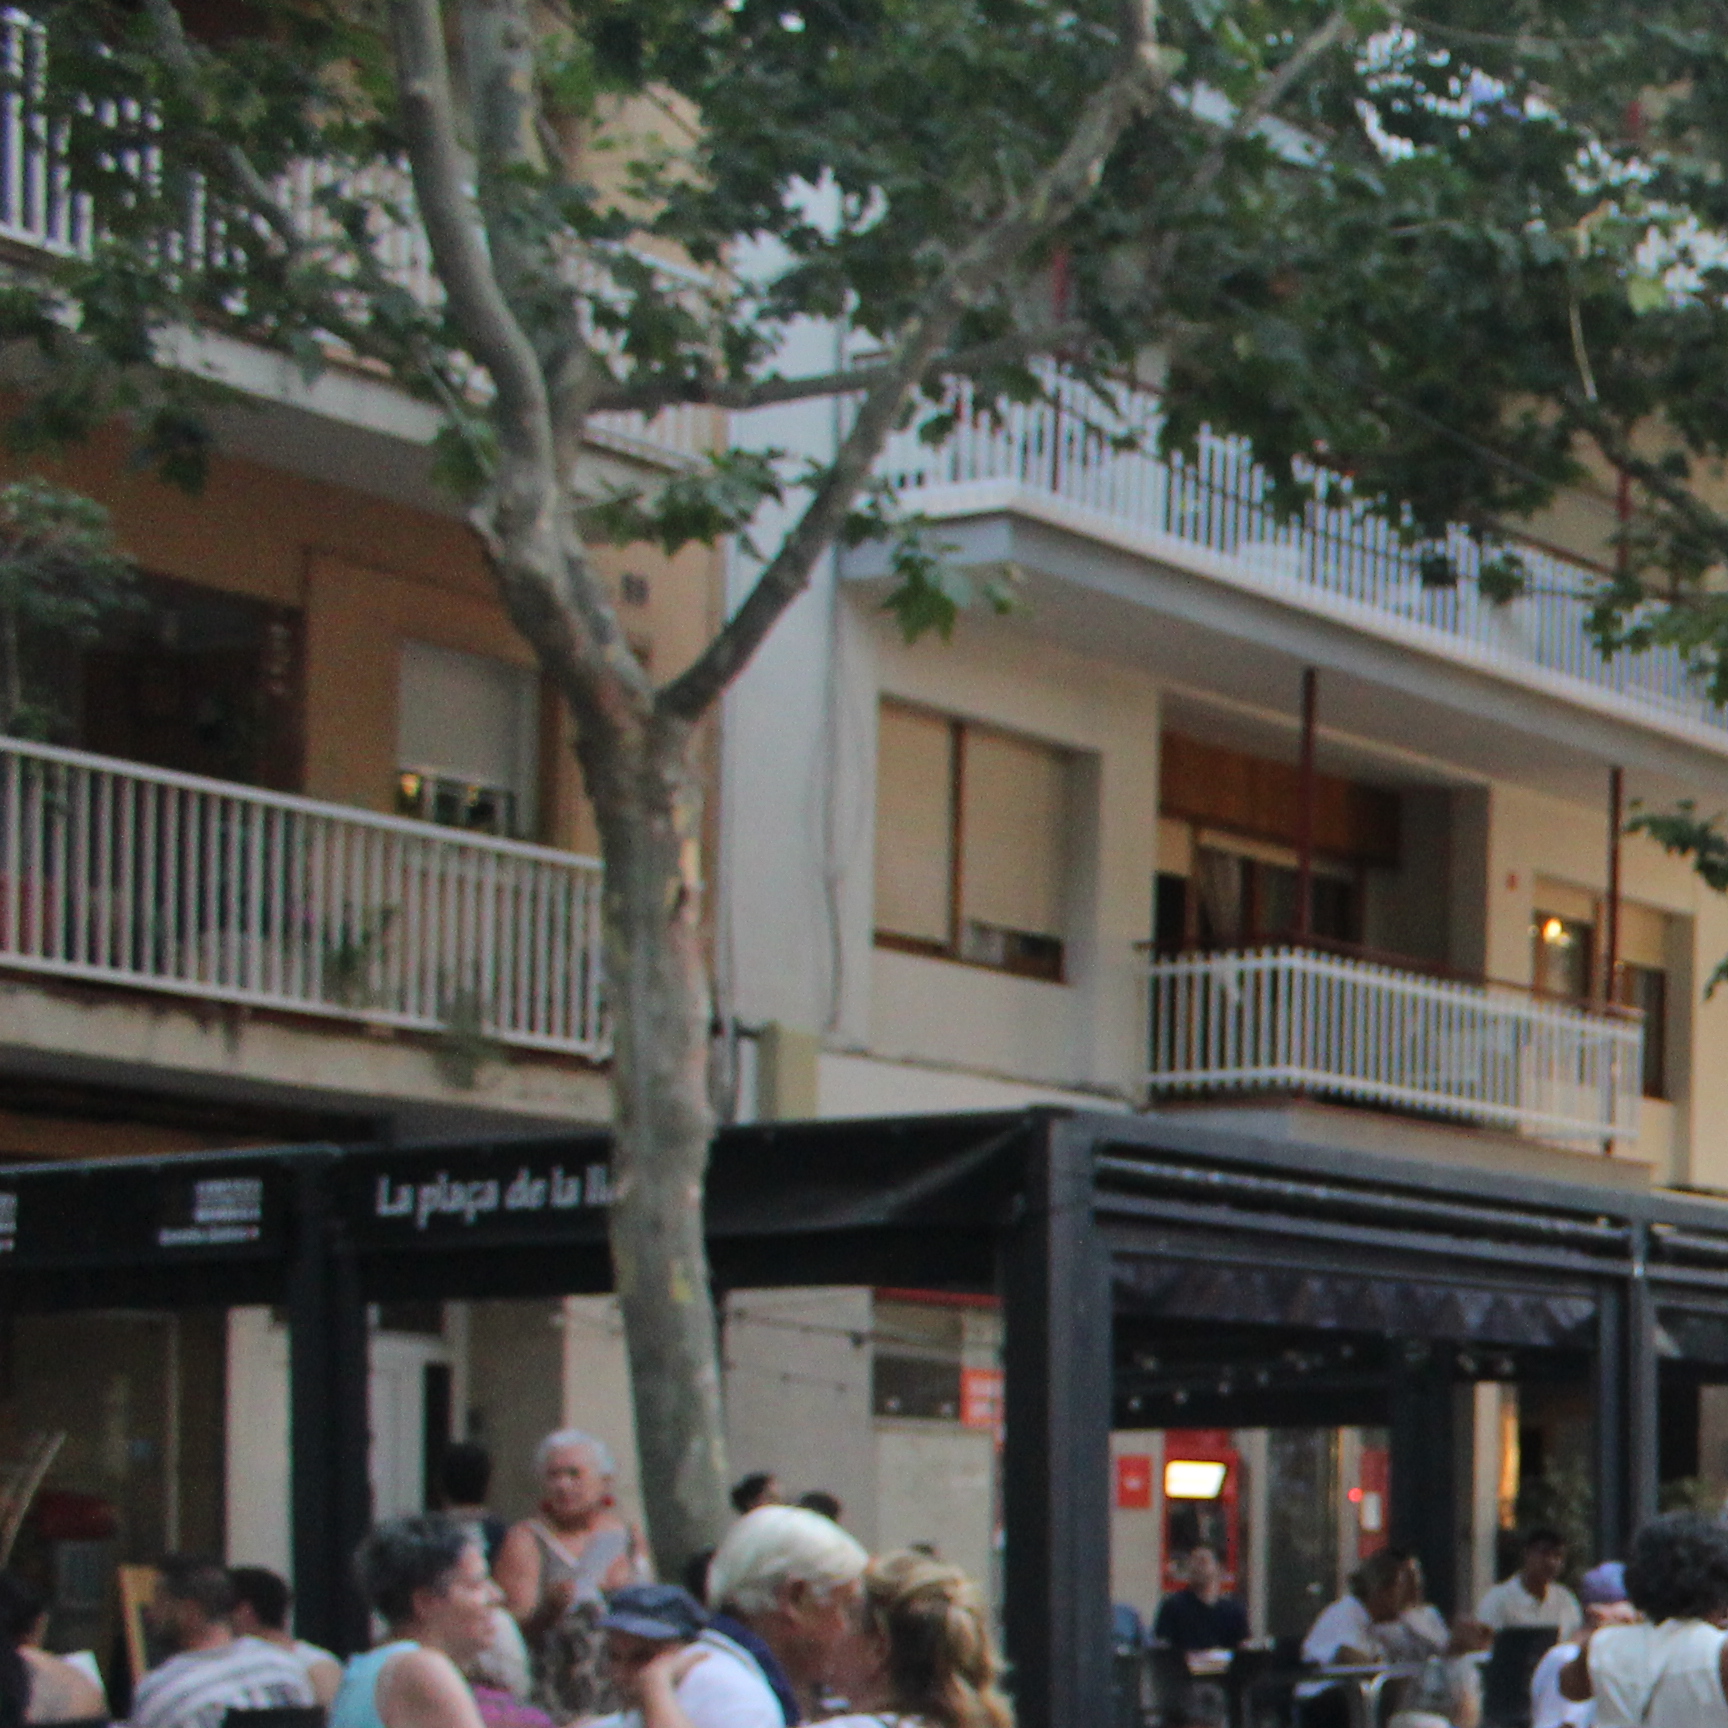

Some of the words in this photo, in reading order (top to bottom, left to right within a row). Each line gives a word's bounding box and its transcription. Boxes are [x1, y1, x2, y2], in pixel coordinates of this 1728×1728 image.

[376, 1174, 413, 1216] La
[416, 1169, 499, 1231] plaça
[504, 1165, 549, 1210] de
[550, 1163, 581, 1208] la
